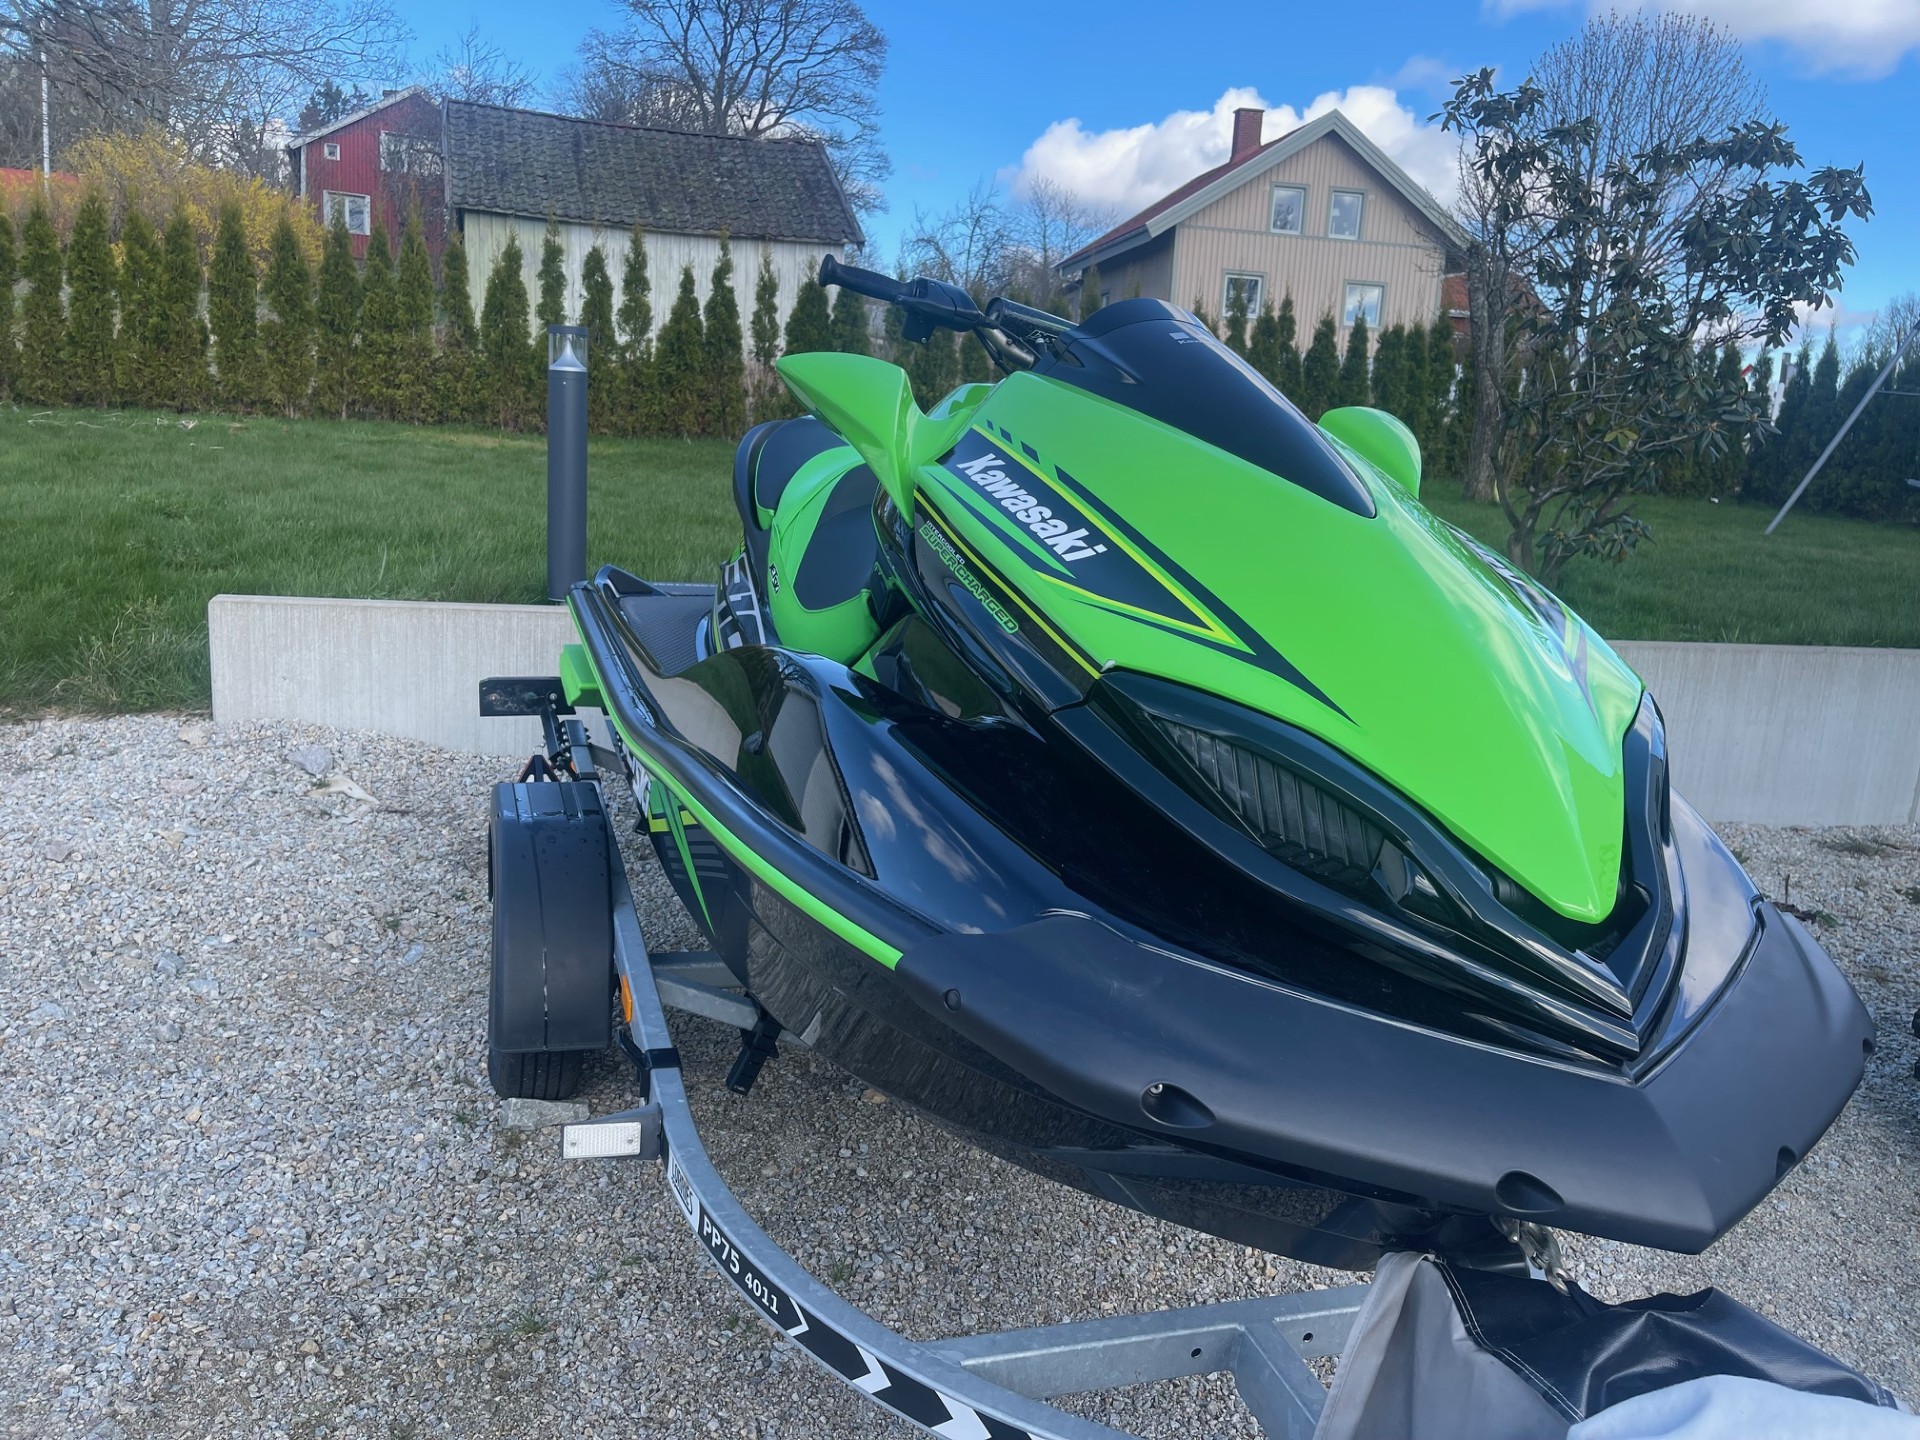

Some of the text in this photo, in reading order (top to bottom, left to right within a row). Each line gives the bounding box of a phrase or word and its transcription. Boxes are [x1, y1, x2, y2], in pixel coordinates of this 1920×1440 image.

[926, 520, 966, 565] INTERCOOLED
[956, 453, 1108, 562] Kawasaki
[919, 524, 1019, 634] SUPERCHARGED
[703, 1215, 779, 1315] PP75 4011
